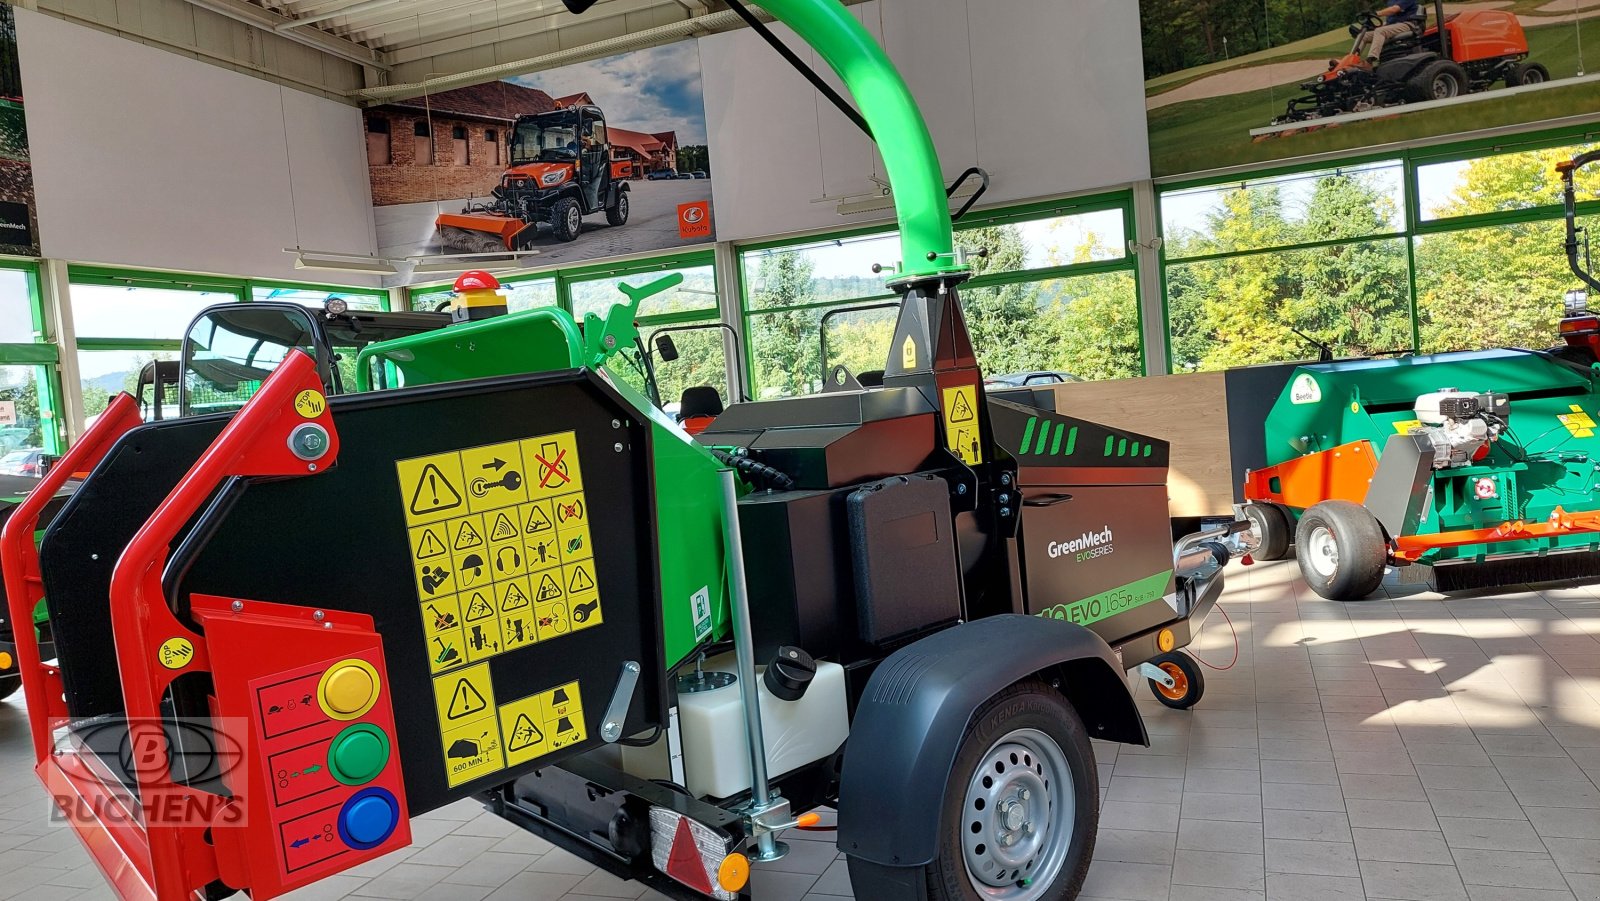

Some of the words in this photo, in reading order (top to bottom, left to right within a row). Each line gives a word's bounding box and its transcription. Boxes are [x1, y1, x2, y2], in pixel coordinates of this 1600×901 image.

[0, 222, 26, 230] eenMech
[682, 225, 708, 233] Kubota
[297, 391, 310, 408] STOP
[1296, 393, 1313, 401] Beetle
[1047, 525, 1113, 558] GreenMech
[1071, 599, 1102, 623] EVO
[163, 645, 173, 665] STOP
[990, 701, 1025, 730] KENDA
[453, 762, 467, 772] 600
[468, 757, 483, 767] MIN
